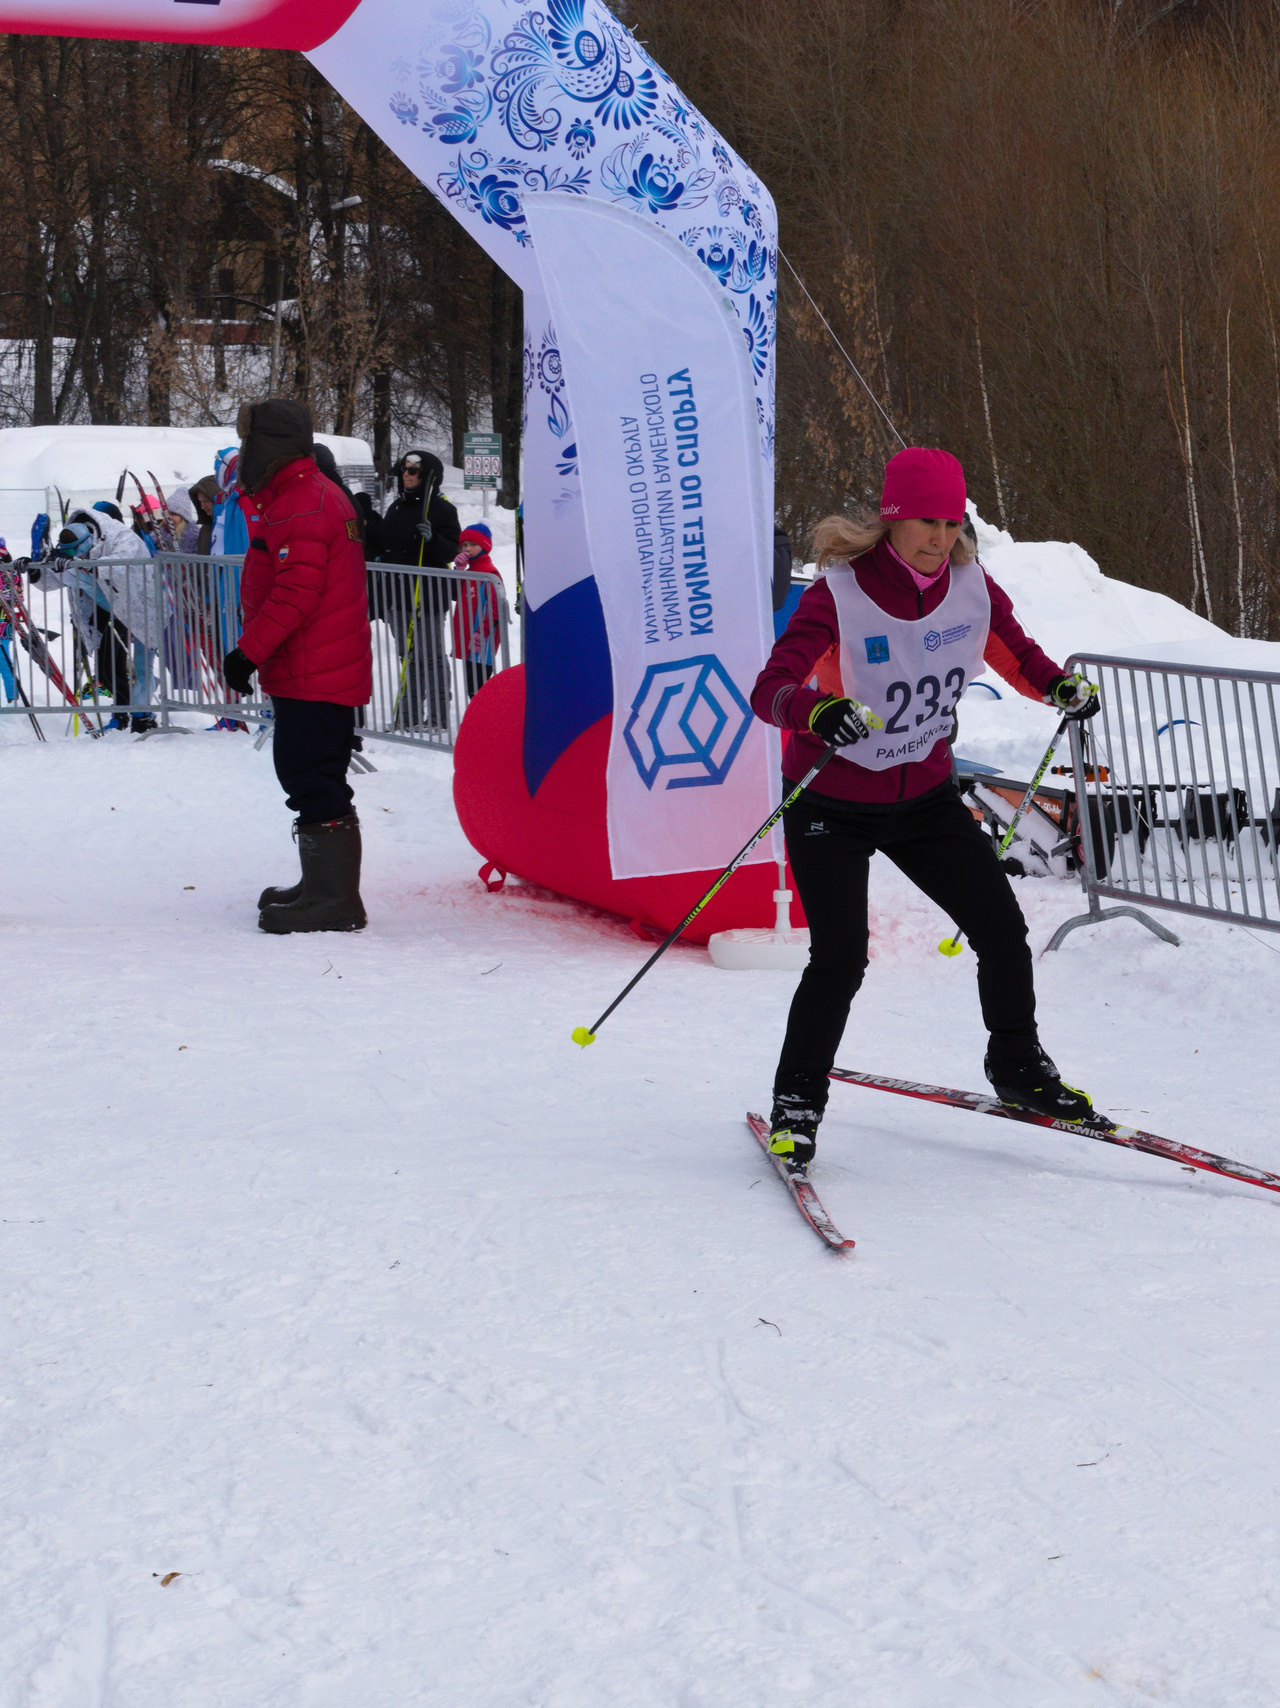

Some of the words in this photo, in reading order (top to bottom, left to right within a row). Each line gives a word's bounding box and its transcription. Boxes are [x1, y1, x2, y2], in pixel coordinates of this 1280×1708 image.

[885, 667, 966, 735] 233
[845, 1073, 939, 1095] ATOMIC
[1051, 1120, 1105, 1140] ATOMIC
